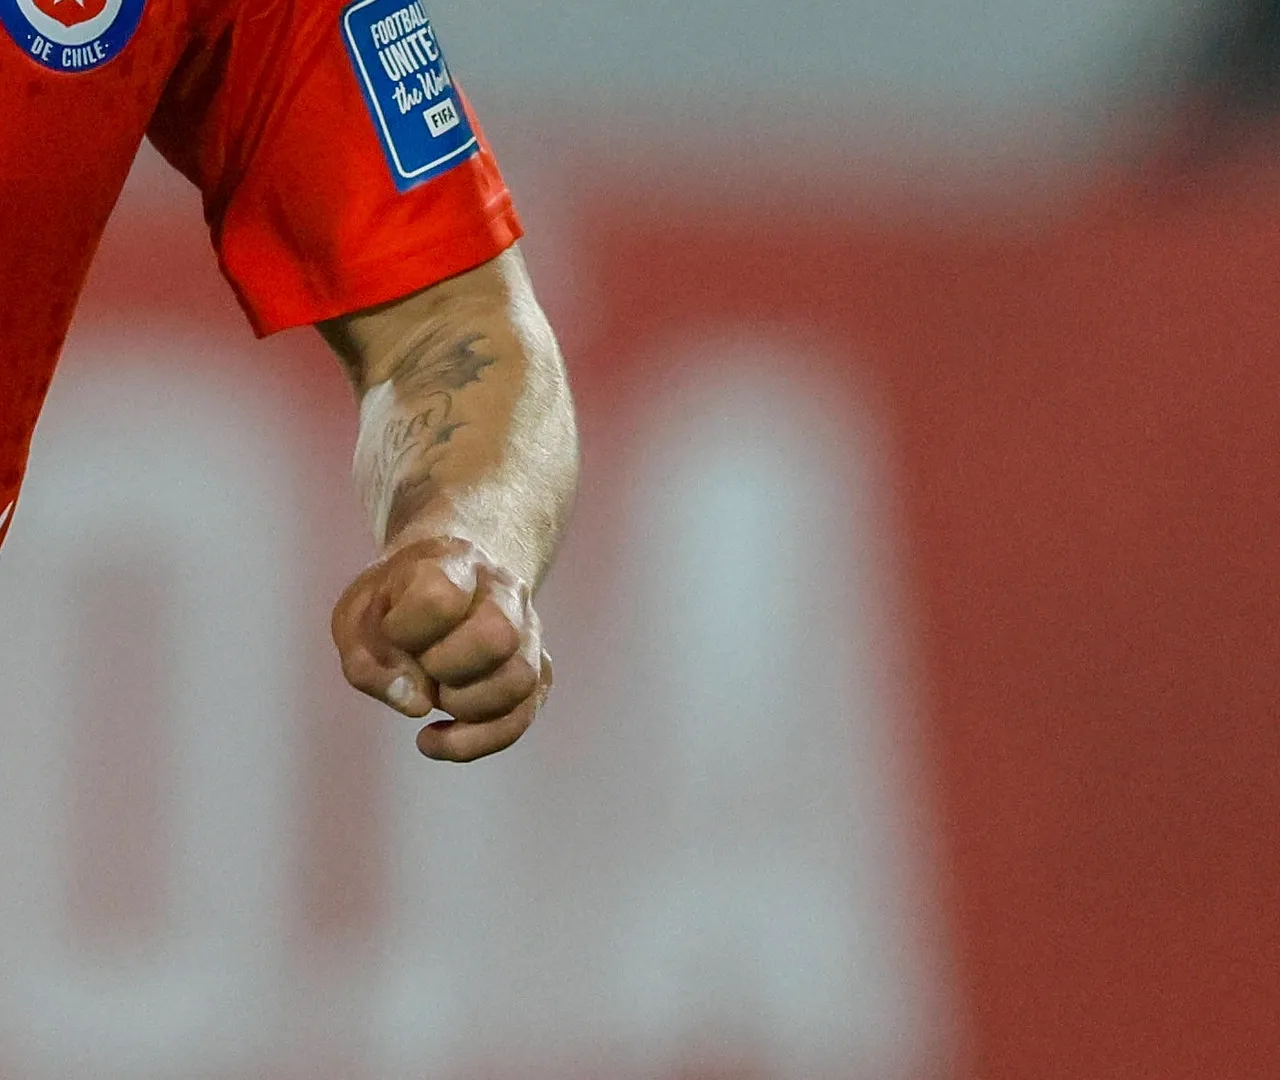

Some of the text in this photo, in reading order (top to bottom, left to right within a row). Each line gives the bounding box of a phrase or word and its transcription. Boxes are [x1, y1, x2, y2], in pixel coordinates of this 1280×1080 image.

[31, 35, 106, 68] DE CHILE
[392, 81, 422, 115] the
[431, 105, 455, 129] FIFA
